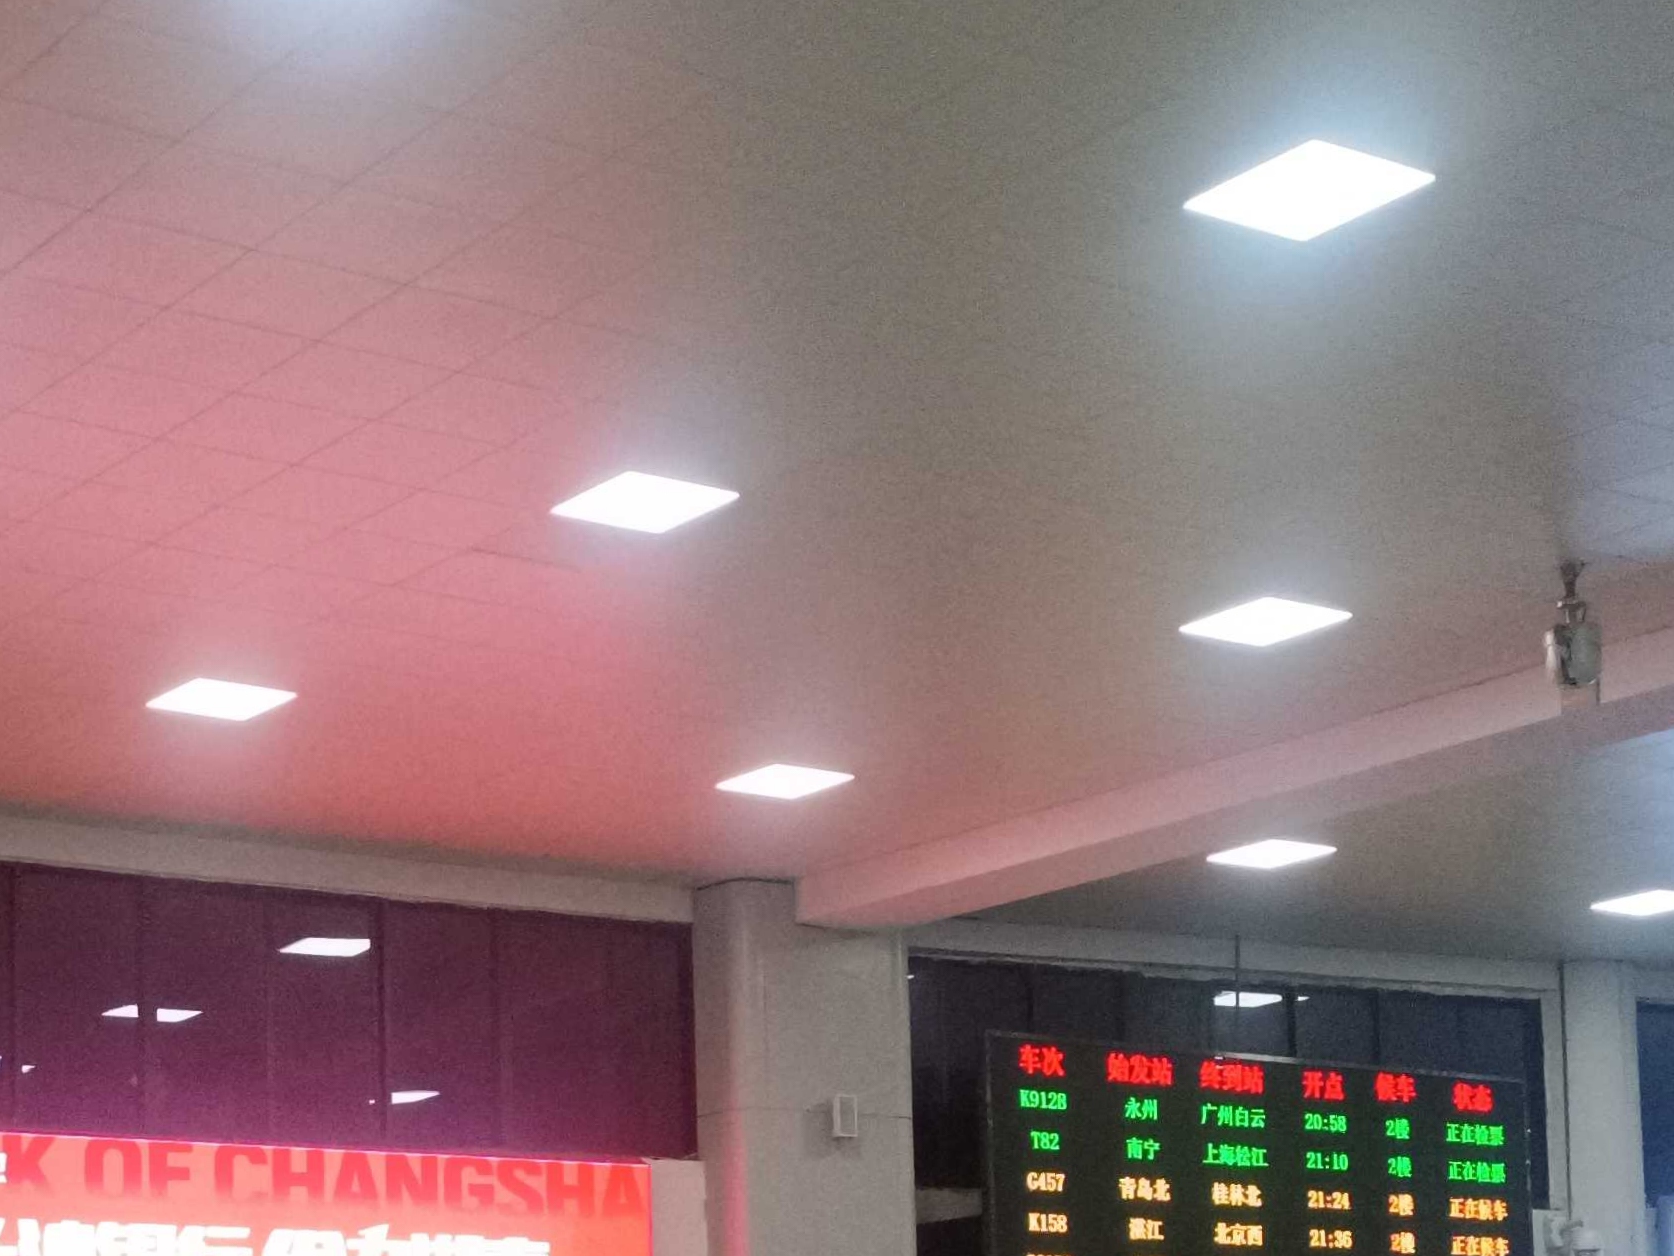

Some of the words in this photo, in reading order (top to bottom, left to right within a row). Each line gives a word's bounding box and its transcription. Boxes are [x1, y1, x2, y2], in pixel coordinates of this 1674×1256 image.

[1019, 1045, 1064, 1078] 车次
[1303, 1071, 1345, 1099] 开点
[1020, 1089, 1067, 1110] K9128
[1126, 1097, 1158, 1120] 永州
[1201, 1104, 1265, 1127] 广州白云
[1305, 1114, 1347, 1133] 20:58
[1447, 1124, 1504, 1146] 正在检票
[84, 1138, 194, 1198] OF
[213, 1144, 646, 1216] CHANGSHA
[1031, 1131, 1059, 1150] T82
[1127, 1137, 1160, 1160] 南宁
[1203, 1144, 1269, 1167] 上海松江
[1307, 1152, 1349, 1171] 21:10
[1449, 1161, 1506, 1183] 正在检票
[1028, 1172, 1065, 1192] G457
[1119, 1177, 1171, 1201] 青岛北
[1212, 1182, 1262, 1208] 桂林北
[1308, 1191, 1350, 1209] 21:24
[1450, 1198, 1508, 1221] 正在候车
[1029, 1213, 1067, 1233] K158
[1129, 1218, 1163, 1240] 湛江
[1215, 1222, 1262, 1246] 北京西
[1309, 1229, 1352, 1248] 21:36
